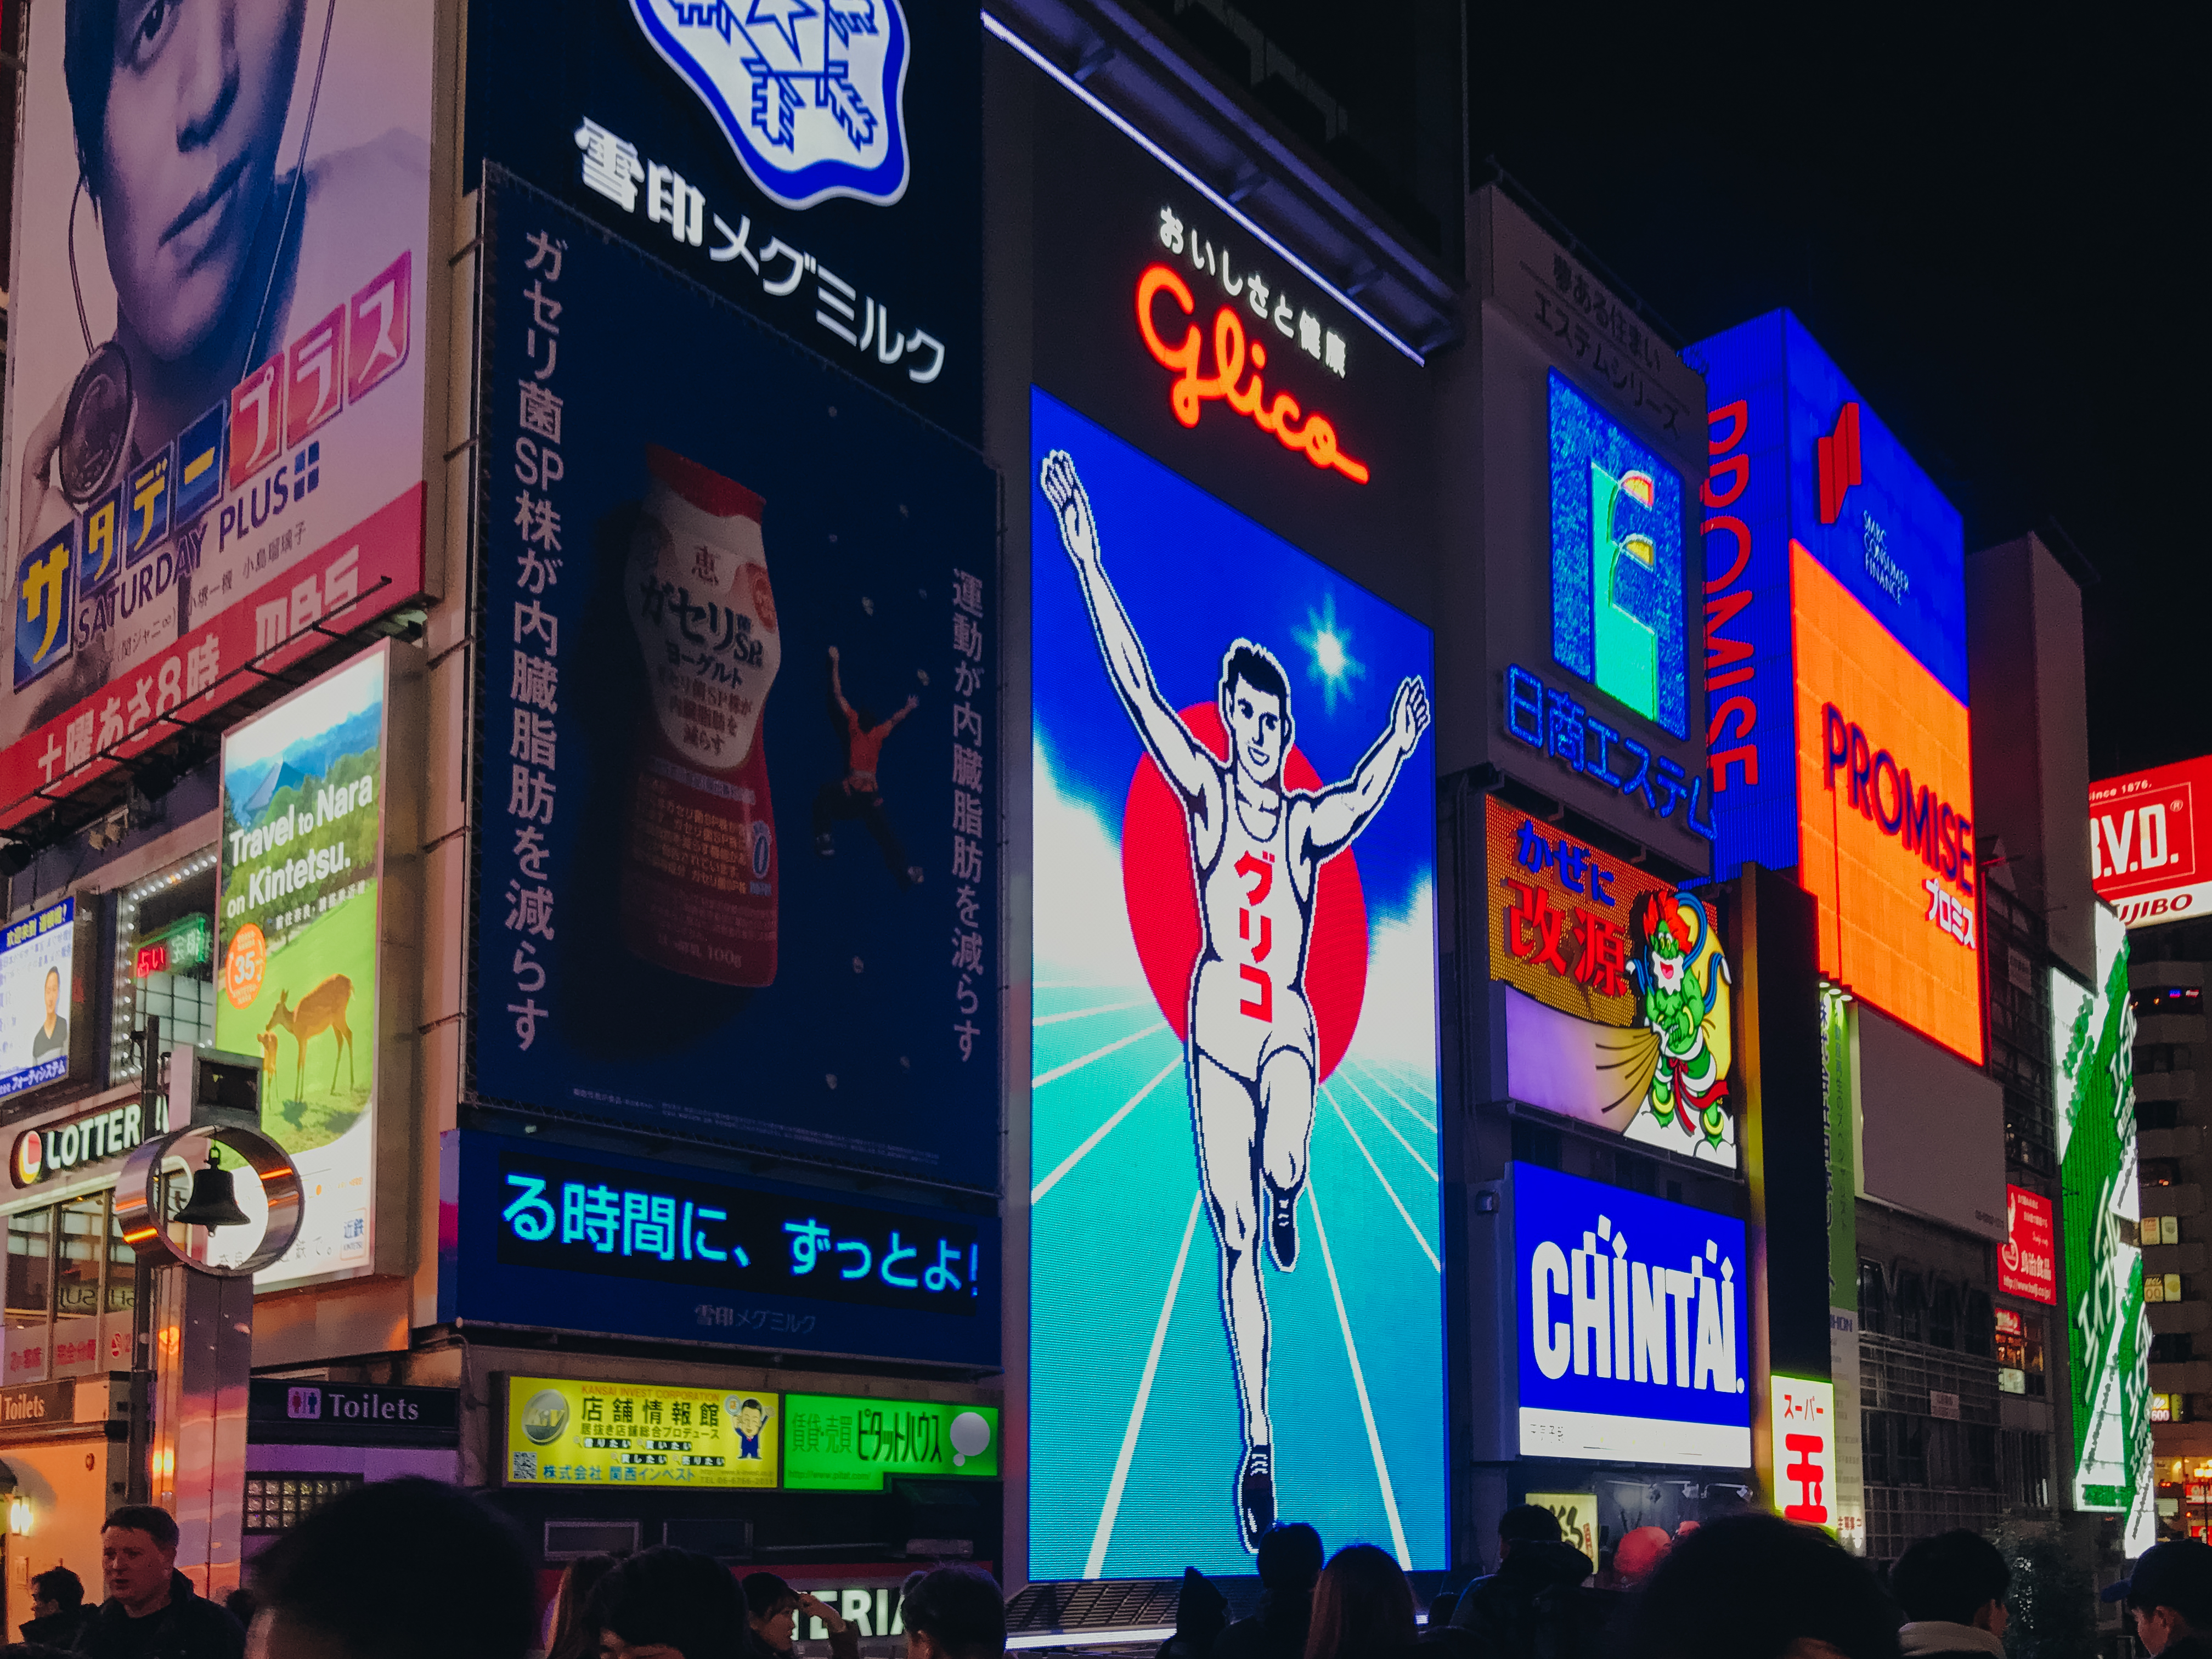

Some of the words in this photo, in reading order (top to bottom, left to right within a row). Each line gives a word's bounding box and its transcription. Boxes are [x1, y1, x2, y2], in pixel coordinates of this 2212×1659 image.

[574, 115, 945, 383] 雪印メグミルク
[1137, 266, 1370, 486] Glico
[78, 522, 208, 646] SATURDAY
[220, 466, 289, 553] PLUS
[504, 229, 568, 1051] ガセリ菌SP株が内臓脂肪を減らす
[37, 633, 221, 788] 土曜あさ8時
[230, 803, 295, 867] Travel
[298, 811, 314, 836] to
[317, 774, 373, 828] Nara
[951, 568, 984, 1063] 運動が内臓脂肪を減らす
[1821, 701, 1974, 897] PROMISE
[227, 895, 245, 919] on
[249, 840, 351, 909] Kintetsu.
[1517, 819, 1616, 907] かぜに
[1234, 849, 1276, 1024] グリコ
[1506, 880, 1627, 997] 改源
[1922, 877, 1976, 950] プロミス
[234, 951, 255, 985] 35
[47, 1094, 170, 1170] LOTTERA
[503, 1173, 751, 1269] る時間に、
[783, 1218, 979, 1297] ずっとよ!
[1531, 1214, 1746, 1395] CHINTAI.
[4, 1393, 45, 1420] Toilets
[329, 1393, 419, 1420] Toilets
[580, 1423, 720, 1440] 居抜き店舗総合プロデュース
[582, 1385, 617, 1396] KANSAI
[620, 1387, 653, 1398] INVEST
[656, 1389, 720, 1402] CORPORATION
[582, 1396, 720, 1427] 店舗情報館
[1784, 1394, 1824, 1421] スーパー
[2151, 1409, 2170, 1421] 600
[543, 1465, 602, 1481] 株式会社
[609, 1465, 696, 1482] 関西インベスト
[857, 1408, 943, 1463] ピタットハウス
[700, 1476, 715, 1485] TEL
